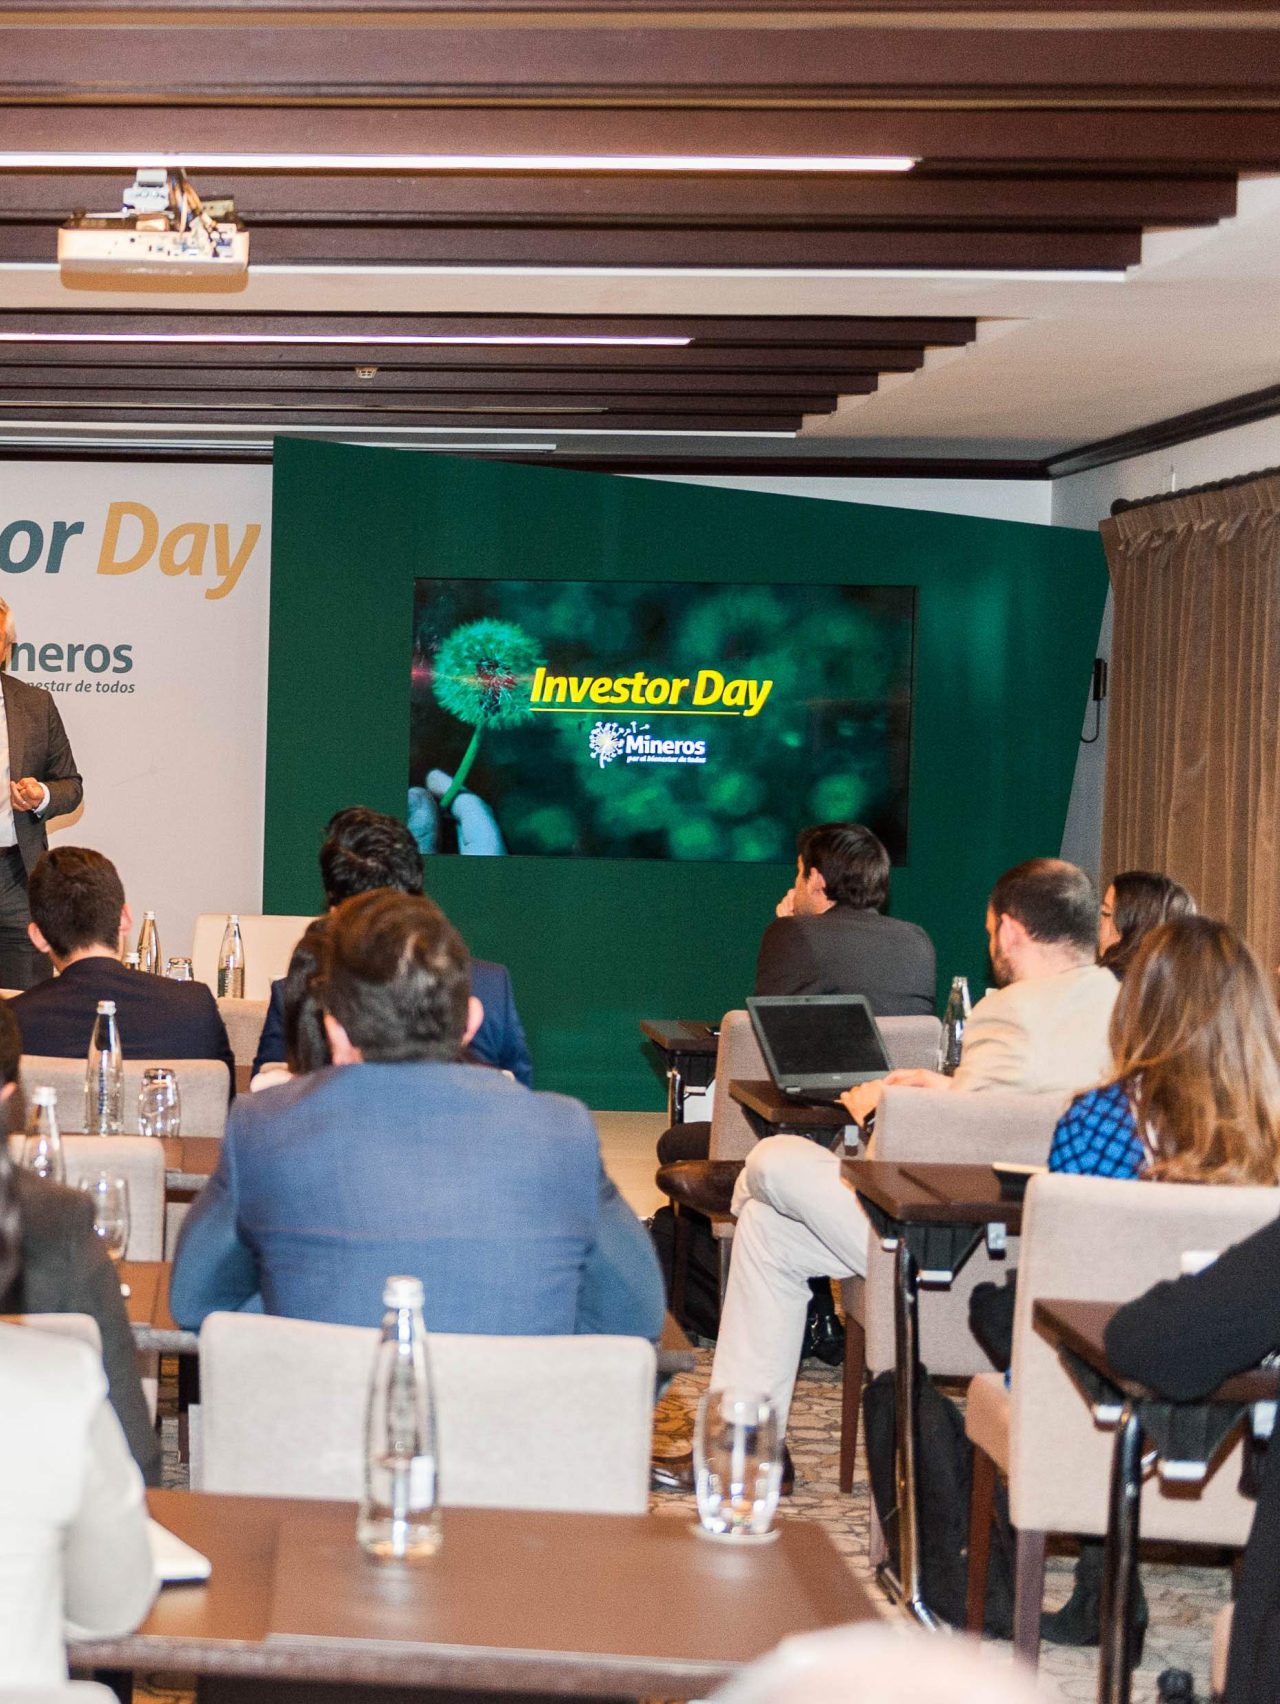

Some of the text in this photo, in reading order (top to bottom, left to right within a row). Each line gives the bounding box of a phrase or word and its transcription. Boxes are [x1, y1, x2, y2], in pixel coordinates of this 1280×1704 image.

[96, 501, 262, 600] Day
[0, 642, 133, 674] neros
[75, 680, 92, 692] de
[96, 680, 135, 693] todos
[530, 667, 773, 717] Investor Day
[625, 735, 705, 755] Mineros
